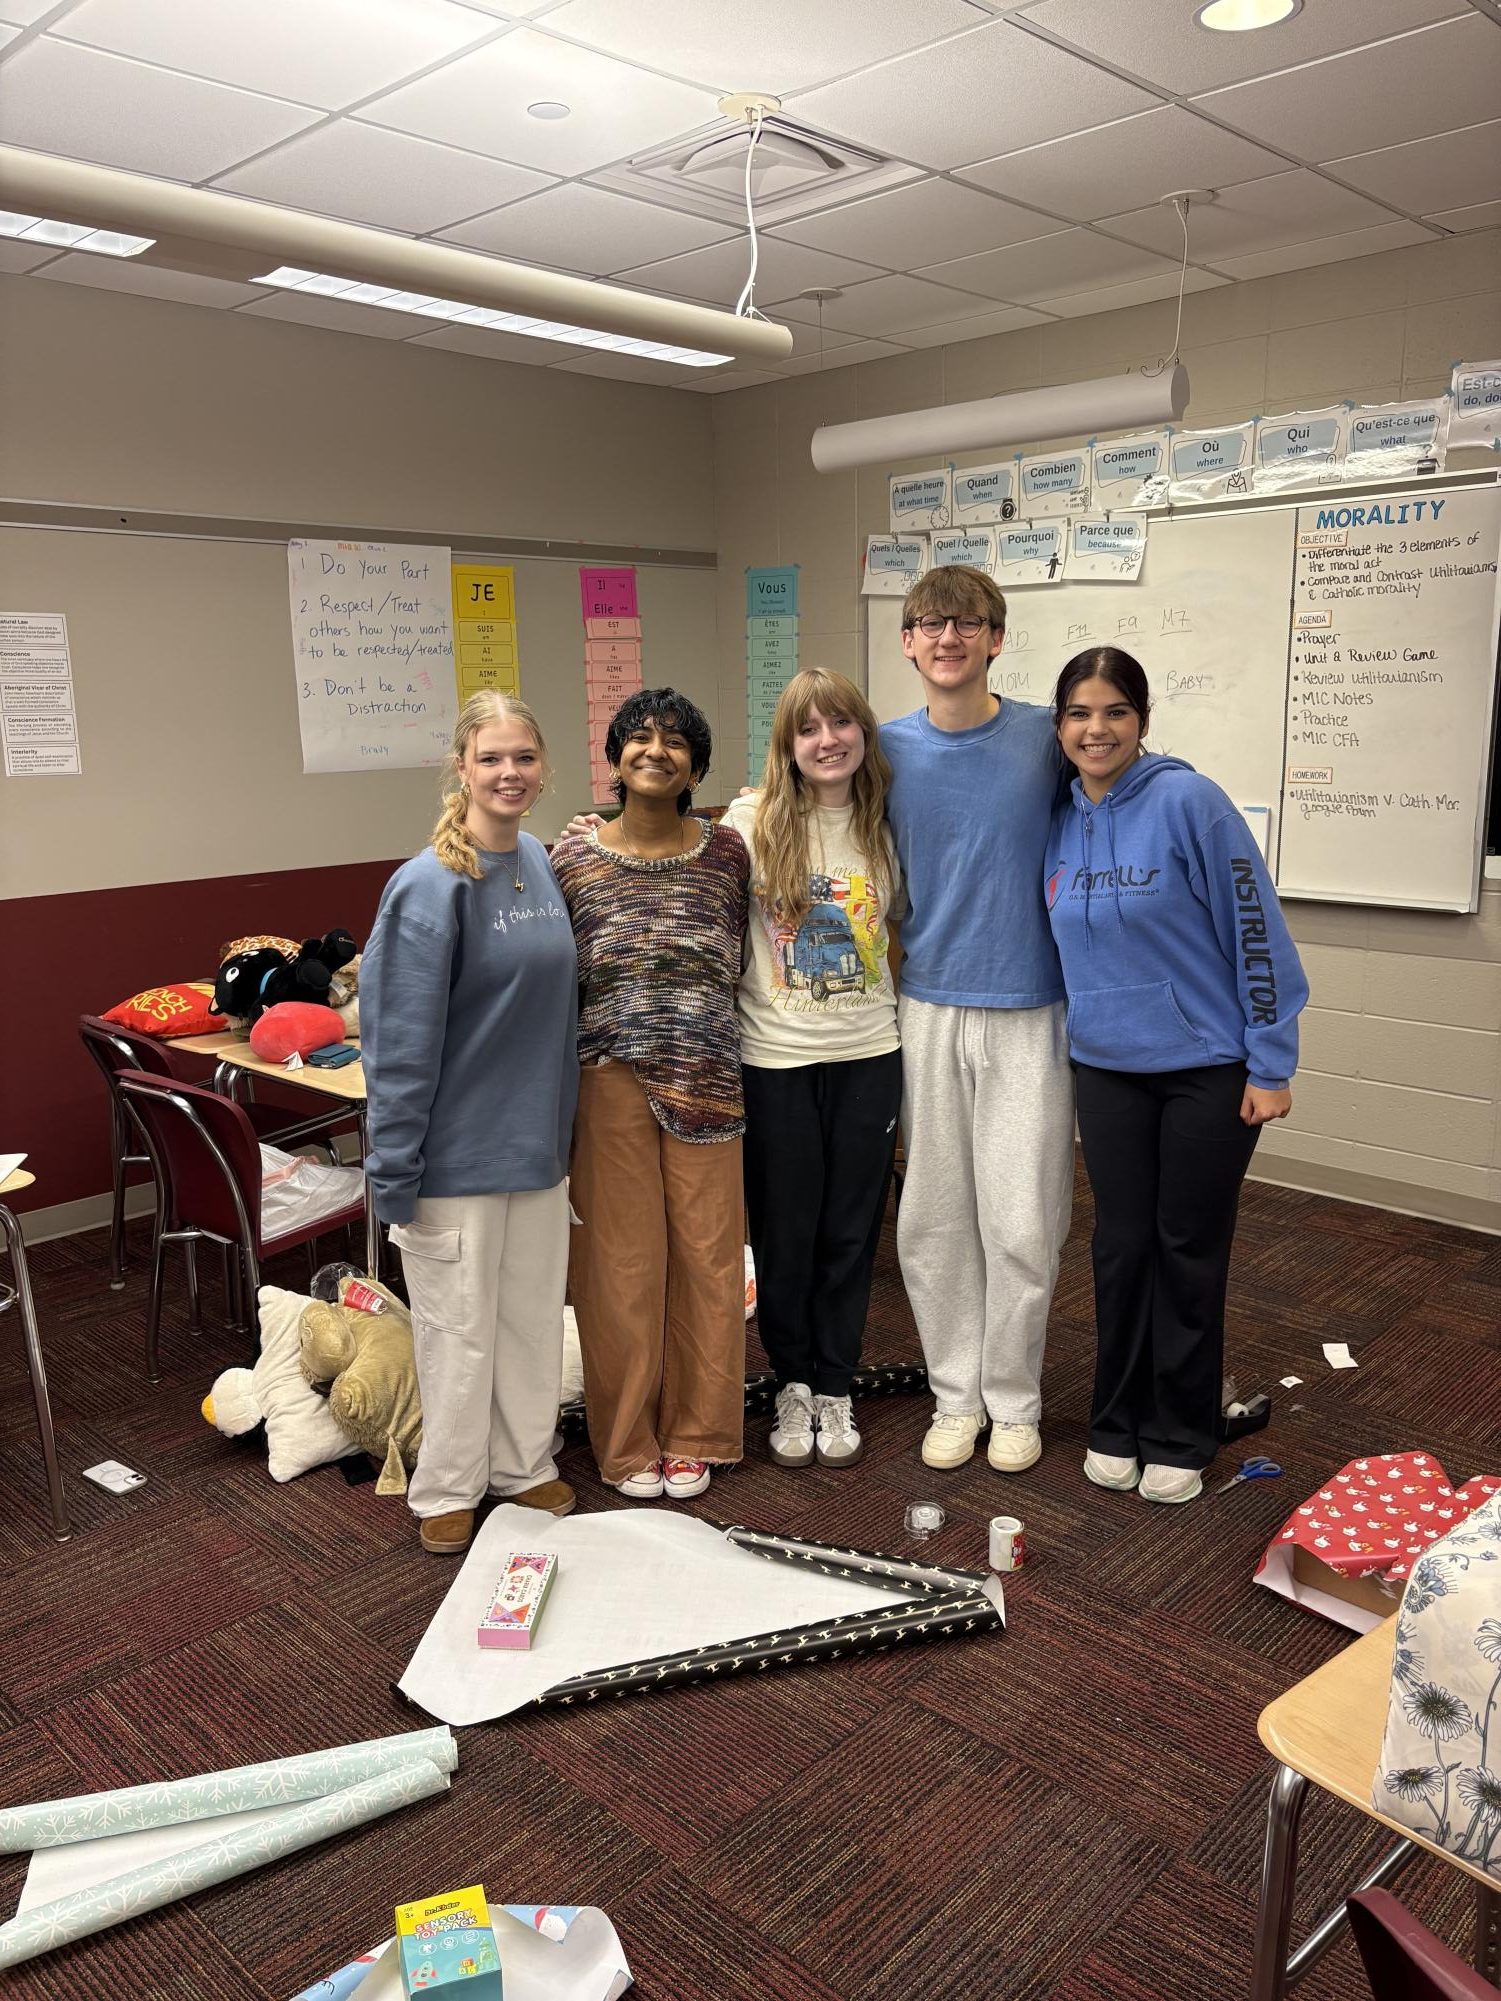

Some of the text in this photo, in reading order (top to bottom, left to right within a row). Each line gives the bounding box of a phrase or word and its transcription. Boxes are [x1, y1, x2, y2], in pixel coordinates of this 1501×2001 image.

[1464, 393, 1501, 406] do, do
[1356, 413, 1436, 434] Qu'est-ce que
[1287, 426, 1310, 442] Qui
[1380, 435, 1406, 446] what
[1202, 440, 1220, 453] Où
[1287, 445, 1308, 455] who
[1103, 447, 1156, 464] Comment
[1196, 456, 1224, 467] where
[1030, 462, 1076, 478] Combien
[1119, 465, 1136, 475] how
[901, 484, 922, 495] quelle
[923, 480, 944, 490] heure
[967, 476, 999, 490] Quand
[1033, 478, 1073, 491] how many
[898, 495, 939, 508] at what time
[973, 491, 992, 500] when
[1316, 500, 1446, 529] MORALITY
[1080, 525, 1134, 537] Parce que
[1300, 533, 1343, 544] OBJECTIVE
[936, 539, 956, 551] Quel
[962, 537, 989, 549] Quelle
[1007, 532, 1054, 546] Pourquoi
[1374, 543, 1393, 554] the
[1399, 541, 1407, 553] 3
[1410, 536, 1461, 552] elements
[1467, 531, 1481, 544] of
[871, 544, 890, 553] Quels
[896, 544, 921, 553] Quelles
[1023, 547, 1039, 556] why
[884, 558, 905, 567] which
[951, 553, 973, 562] which
[1309, 557, 1383, 573] the moral act
[320, 553, 346, 575] Do
[358, 559, 387, 580] Your
[401, 560, 430, 580] Part
[1353, 572, 1372, 583] and
[470, 583, 496, 602] JE
[758, 582, 786, 594] Vous
[1322, 585, 1365, 600] Catholic
[1367, 582, 1421, 598] morality
[594, 603, 614, 614] Elle
[1117, 615, 1138, 633] F9
[1162, 607, 1191, 629] M7
[1298, 615, 1327, 625] AGENDA
[309, 620, 449, 640] others how you want
[477, 625, 494, 633] SUIS
[1003, 627, 1029, 651] AD
[1300, 630, 1341, 648] Prayer
[307, 645, 324, 659] to
[333, 642, 348, 657] be
[482, 647, 491, 655] AI
[1304, 652, 1328, 665] Unit
[1348, 648, 1397, 662] Review
[1403, 647, 1440, 662] Game
[479, 670, 498, 678] AIME
[1301, 670, 1344, 685] Review
[303, 676, 417, 698] 3. Don't be a
[989, 671, 1030, 695] MOM
[1302, 691, 1374, 706] MIC Notes
[347, 698, 427, 716] Distraction
[1300, 709, 1349, 728] Practice
[1302, 731, 1360, 747] MIC CFA
[1292, 770, 1328, 780] HOMEWORK
[1300, 802, 1343, 820] google
[493, 910, 507, 935] if
[508, 905, 533, 923] this
[1231, 858, 1277, 1025] INSTRUCTOR
[125, 993, 176, 1021] RIES
[414, 1915, 477, 1940] TOY PACK
[415, 1908, 473, 1932] SENSORY
